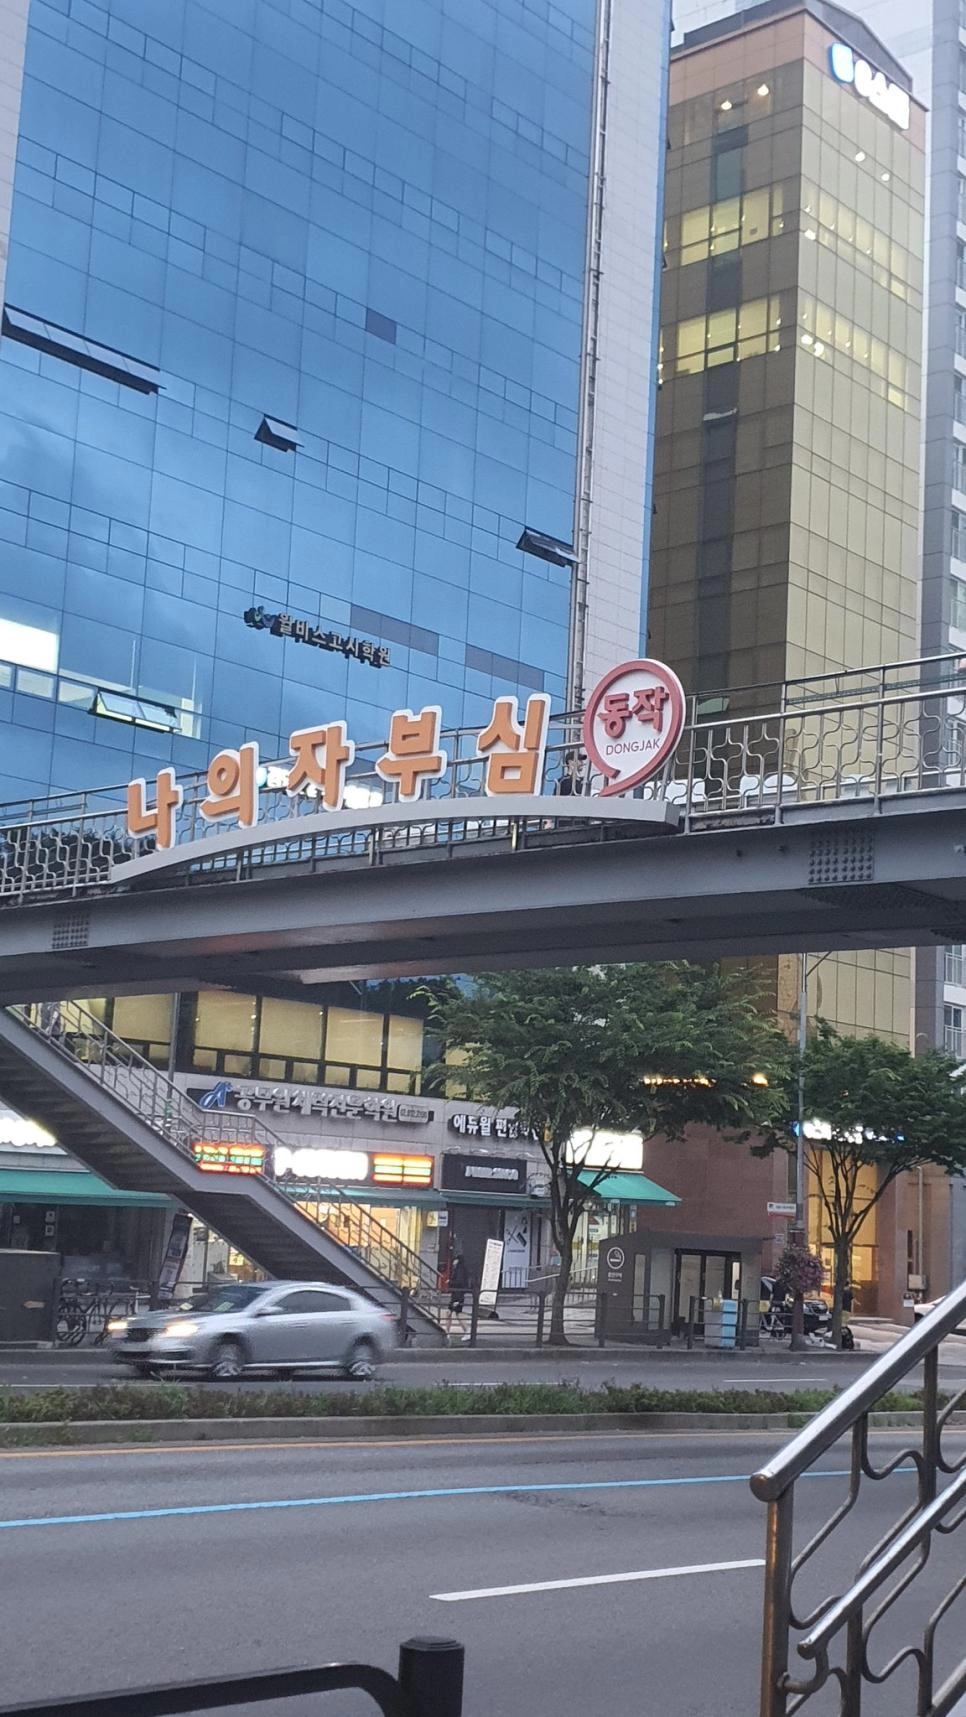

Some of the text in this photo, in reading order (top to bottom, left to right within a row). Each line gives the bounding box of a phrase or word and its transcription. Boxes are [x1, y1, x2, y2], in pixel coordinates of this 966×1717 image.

[597, 686, 670, 739] 동작
[606, 737, 661, 756] DONGJAK
[128, 694, 551, 851] 나의 자부심
[453, 1113, 491, 1137] 에듀윌
